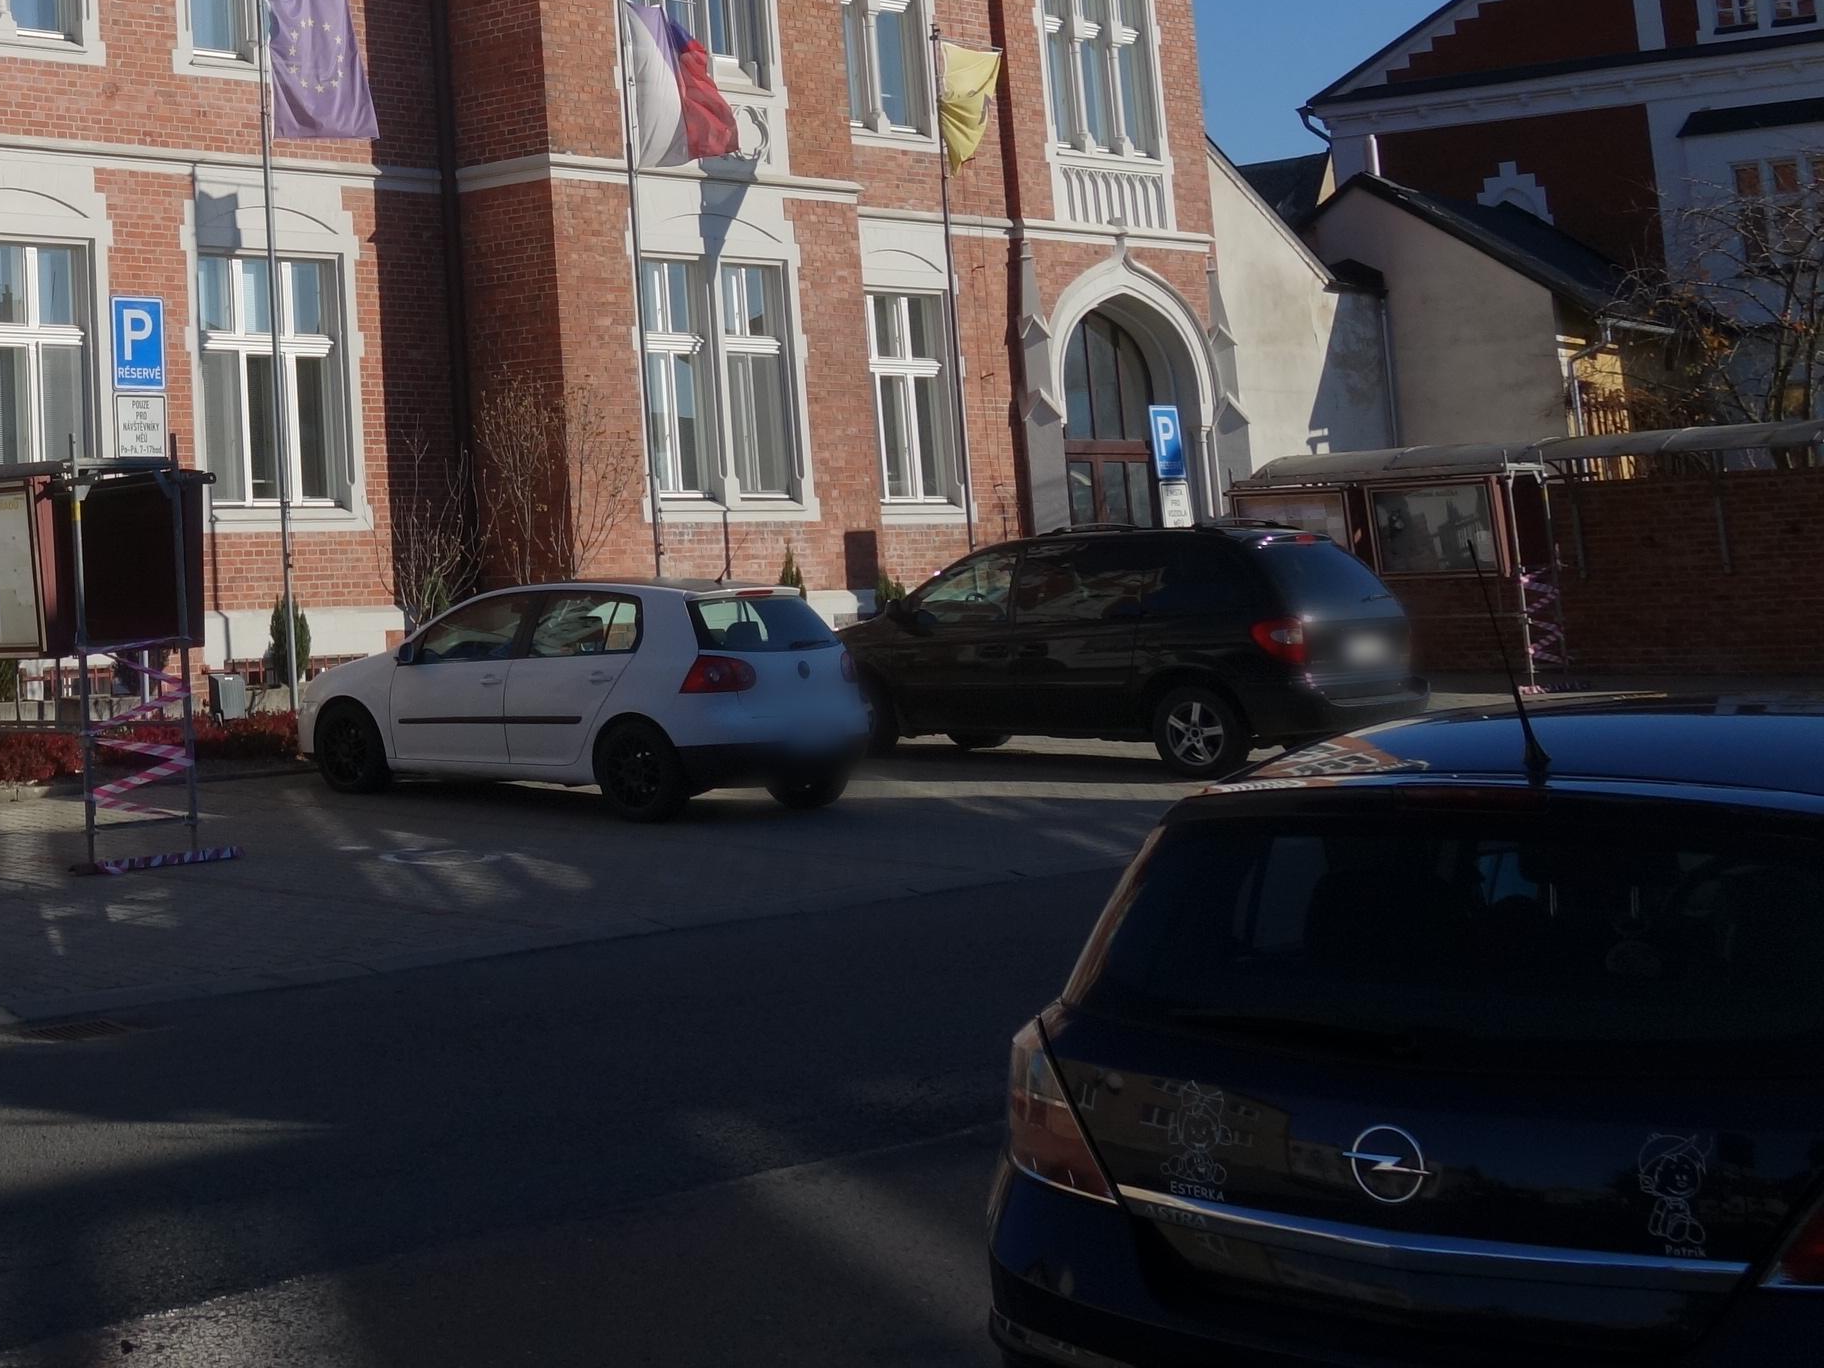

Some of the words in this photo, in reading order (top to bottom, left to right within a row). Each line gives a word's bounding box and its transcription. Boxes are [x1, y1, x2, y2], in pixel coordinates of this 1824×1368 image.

[123, 308, 153, 361] P
[118, 365, 162, 380] RÉSERVÉ
[132, 400, 150, 410] POUZE
[135, 411, 148, 420] PRO
[1157, 416, 1174, 456] P
[1170, 1181, 1225, 1202] ESTERKA
[1144, 1204, 1207, 1227] ASTRA
[1664, 1244, 1707, 1257] Patrik
